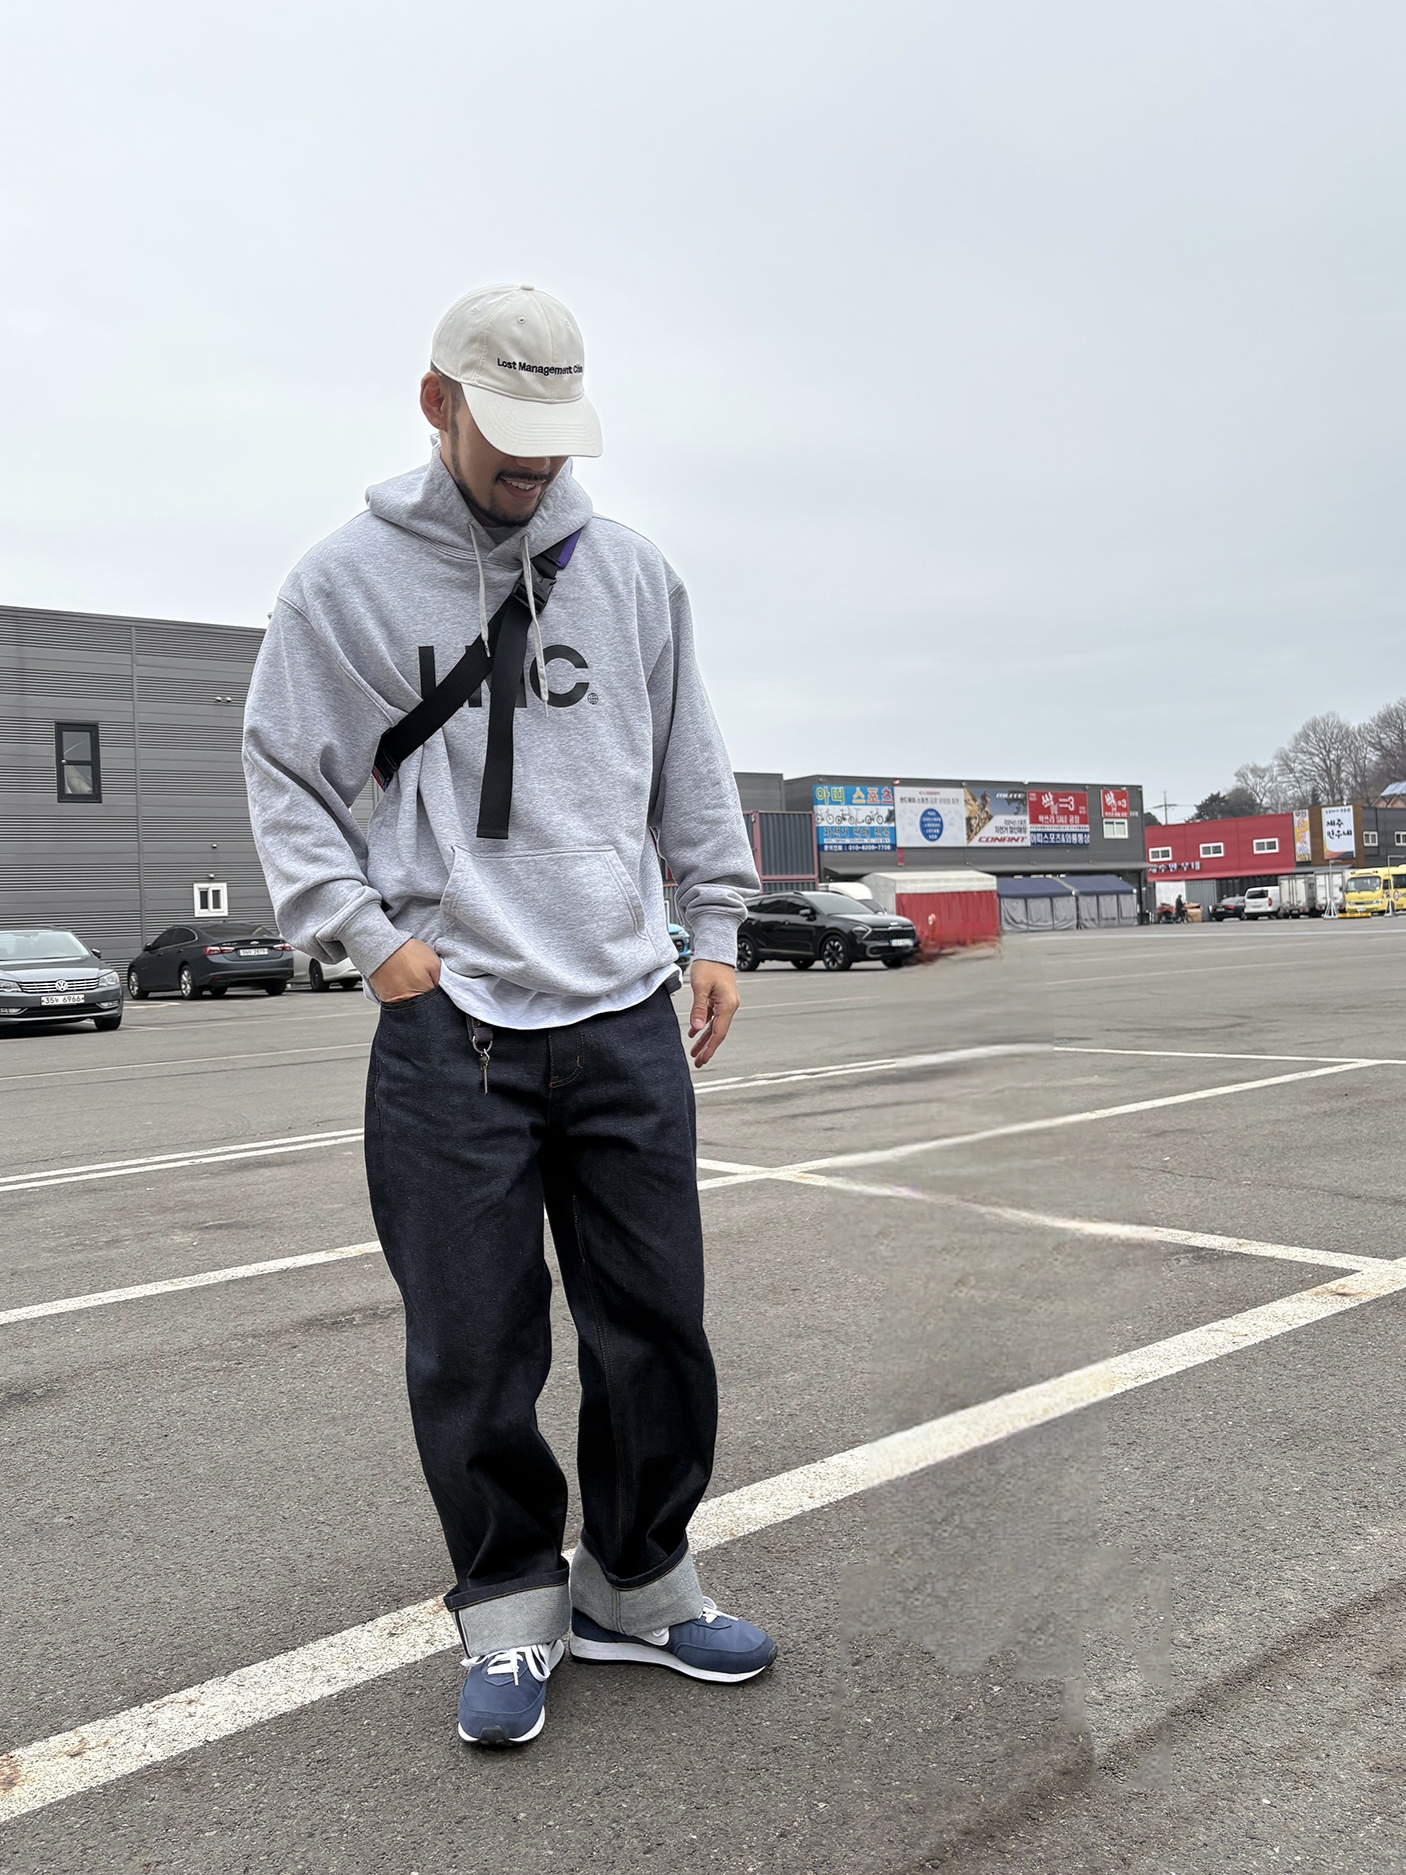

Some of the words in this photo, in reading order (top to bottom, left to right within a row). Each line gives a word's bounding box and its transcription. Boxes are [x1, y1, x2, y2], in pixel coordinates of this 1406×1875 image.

[497, 358, 517, 370] Lost
[518, 362, 573, 376] Management
[816, 787, 845, 805] 아띠
[852, 787, 894, 805] 스포츠
[62, 995, 82, 1004] 6966
